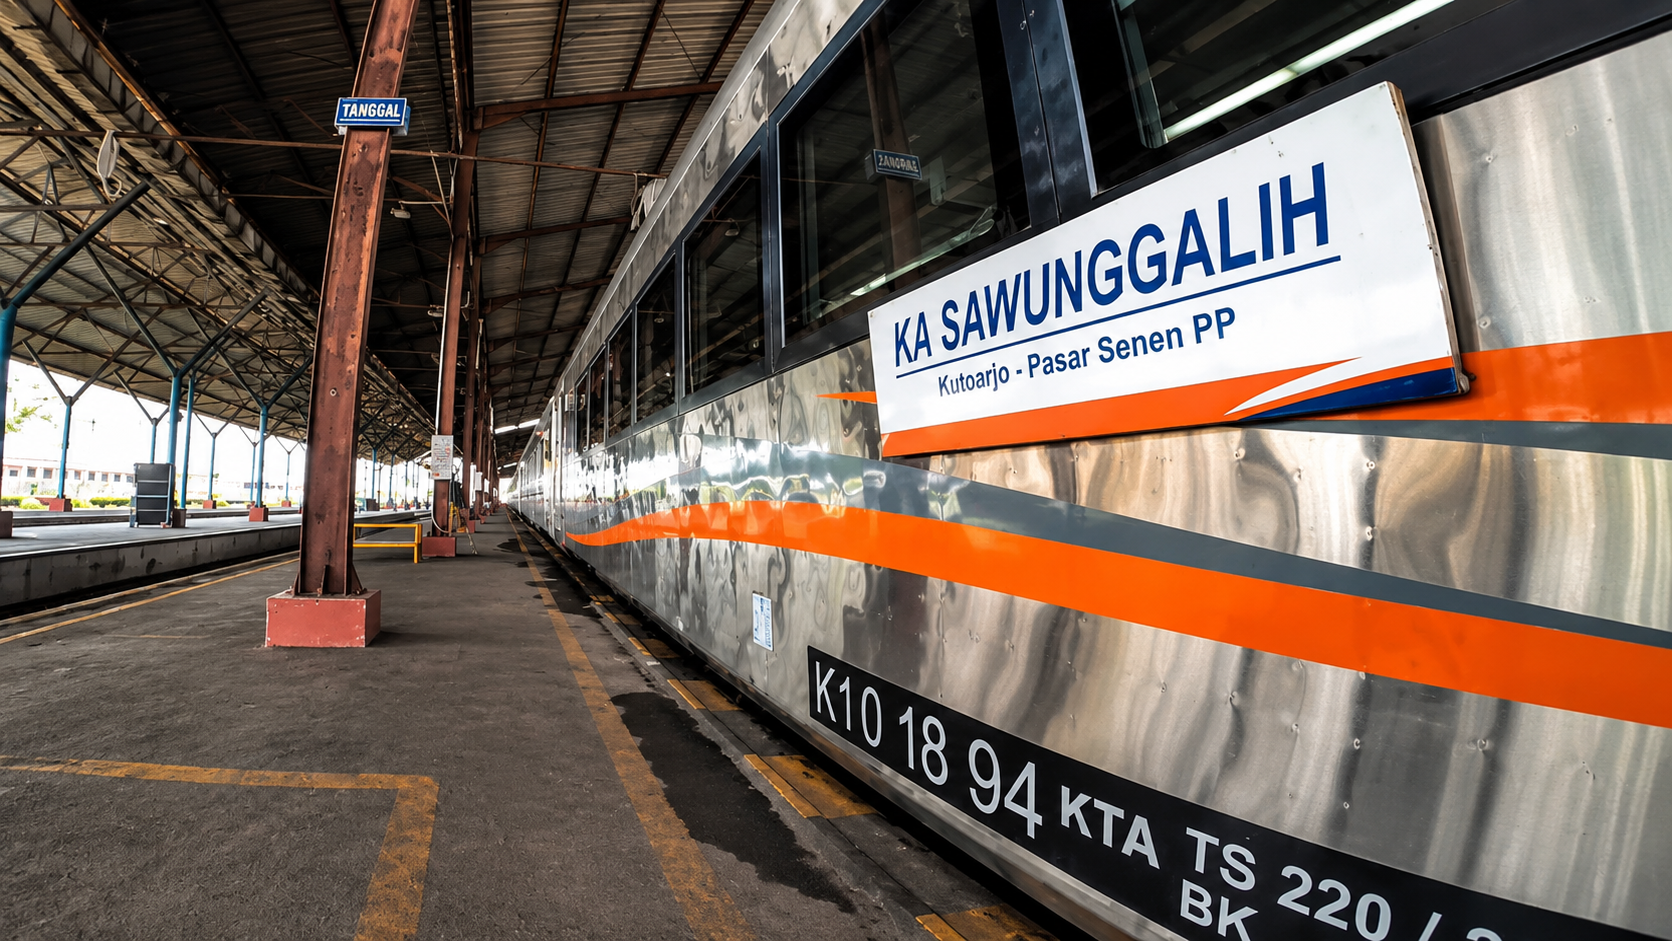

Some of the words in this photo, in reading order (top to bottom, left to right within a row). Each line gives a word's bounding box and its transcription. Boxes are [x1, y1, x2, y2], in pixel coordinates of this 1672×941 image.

[342, 103, 401, 118] TANGGAL
[894, 311, 933, 367] KA
[941, 161, 1329, 351] SAWUNGGALIH
[938, 366, 1010, 396] Kutoarjo
[1027, 347, 1091, 378] Pasar
[1097, 326, 1184, 364] Senen
[1192, 307, 1237, 344] PP
[815, 660, 882, 748] K10
[899, 706, 949, 786] 18
[968, 738, 1043, 840] 94
[1061, 785, 1160, 870] KTA
[1185, 826, 1256, 891] TS
[1276, 865, 1392, 941] 220
[1180, 878, 1259, 941] BK
